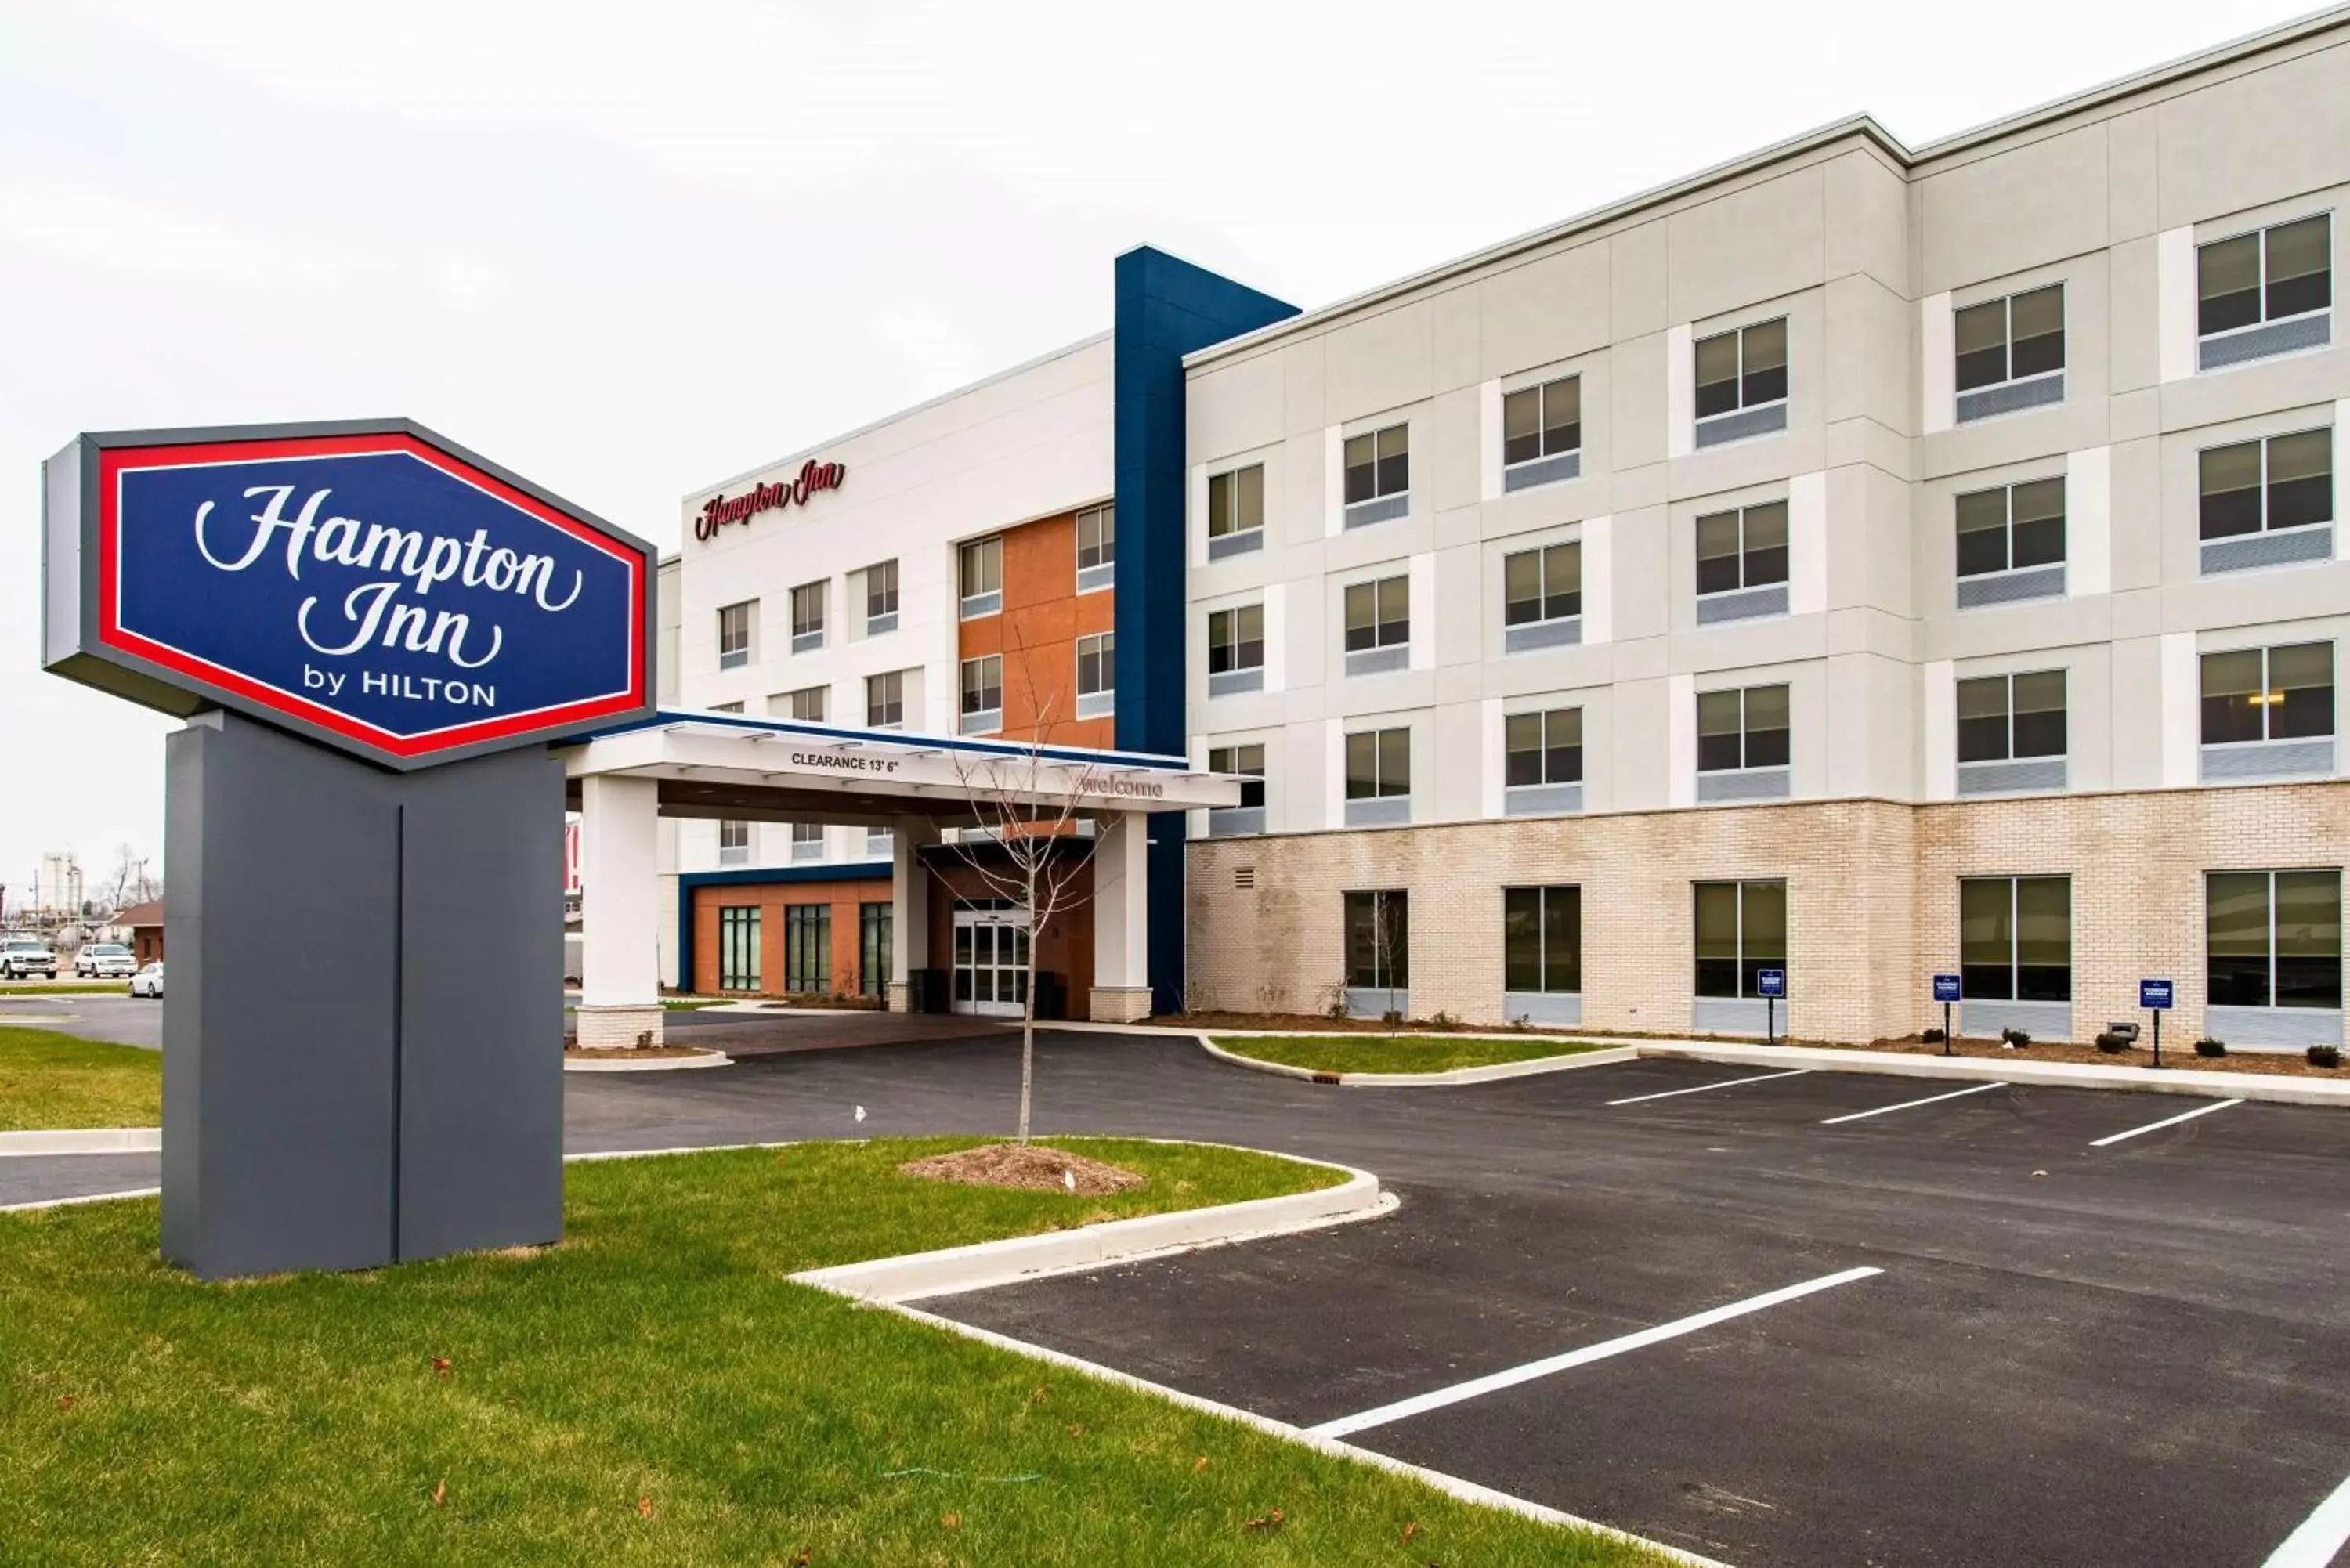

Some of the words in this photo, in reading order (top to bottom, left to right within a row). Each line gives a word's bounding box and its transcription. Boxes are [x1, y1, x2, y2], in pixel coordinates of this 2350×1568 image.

[695, 482, 793, 542] Hampton
[793, 459, 846, 506] Inn
[195, 485, 582, 611] Hampton
[298, 583, 502, 667] Inn
[305, 664, 346, 696] by
[363, 670, 495, 707] HILTON
[792, 753, 866, 769] CLEARANCE
[870, 759, 884, 771] 13'
[1081, 775, 1163, 798] welcome
